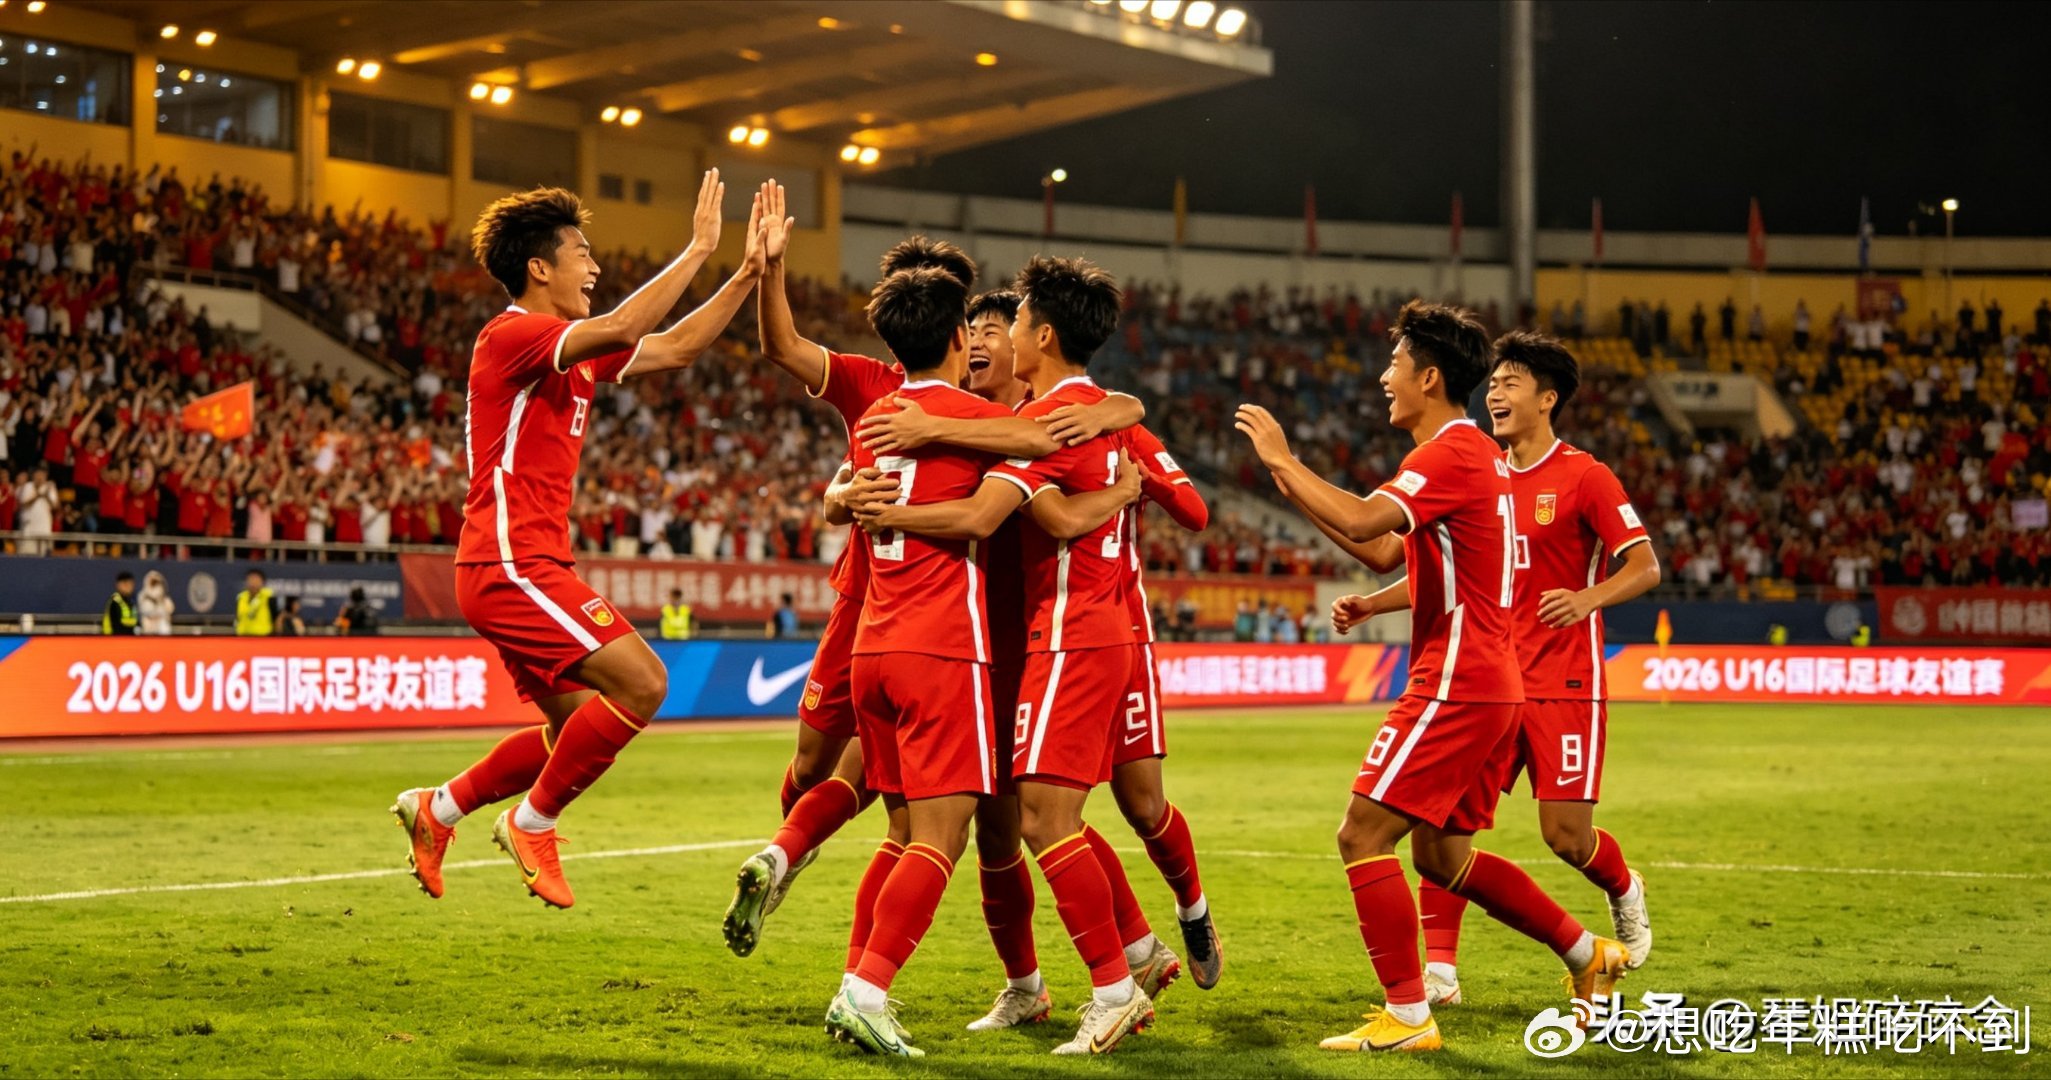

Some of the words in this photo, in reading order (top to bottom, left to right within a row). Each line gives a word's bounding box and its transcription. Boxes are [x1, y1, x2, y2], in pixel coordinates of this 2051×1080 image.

[67, 661, 167, 714] 2026
[175, 656, 487, 715] U16国际足球友谊赛
[1643, 658, 1721, 691] 2026
[1125, 692, 1148, 731] 2
[1365, 725, 1399, 767] 8
[1561, 734, 1582, 772] 8
